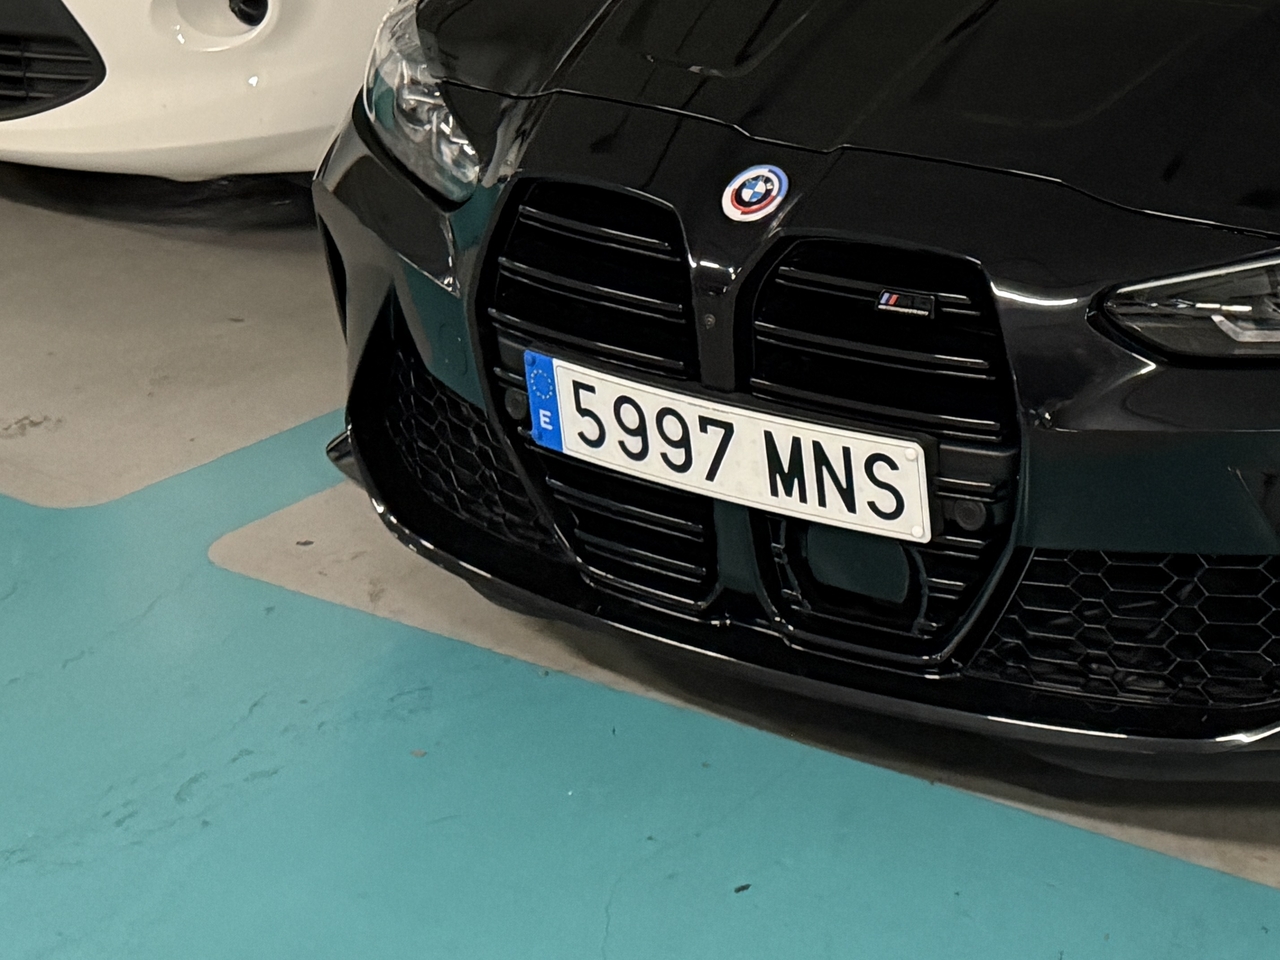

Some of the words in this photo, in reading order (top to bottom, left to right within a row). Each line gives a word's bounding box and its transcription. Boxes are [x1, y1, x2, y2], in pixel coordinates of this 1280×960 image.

[539, 409, 553, 431] E
[571, 378, 735, 483] 5997
[763, 429, 906, 522] MNS
